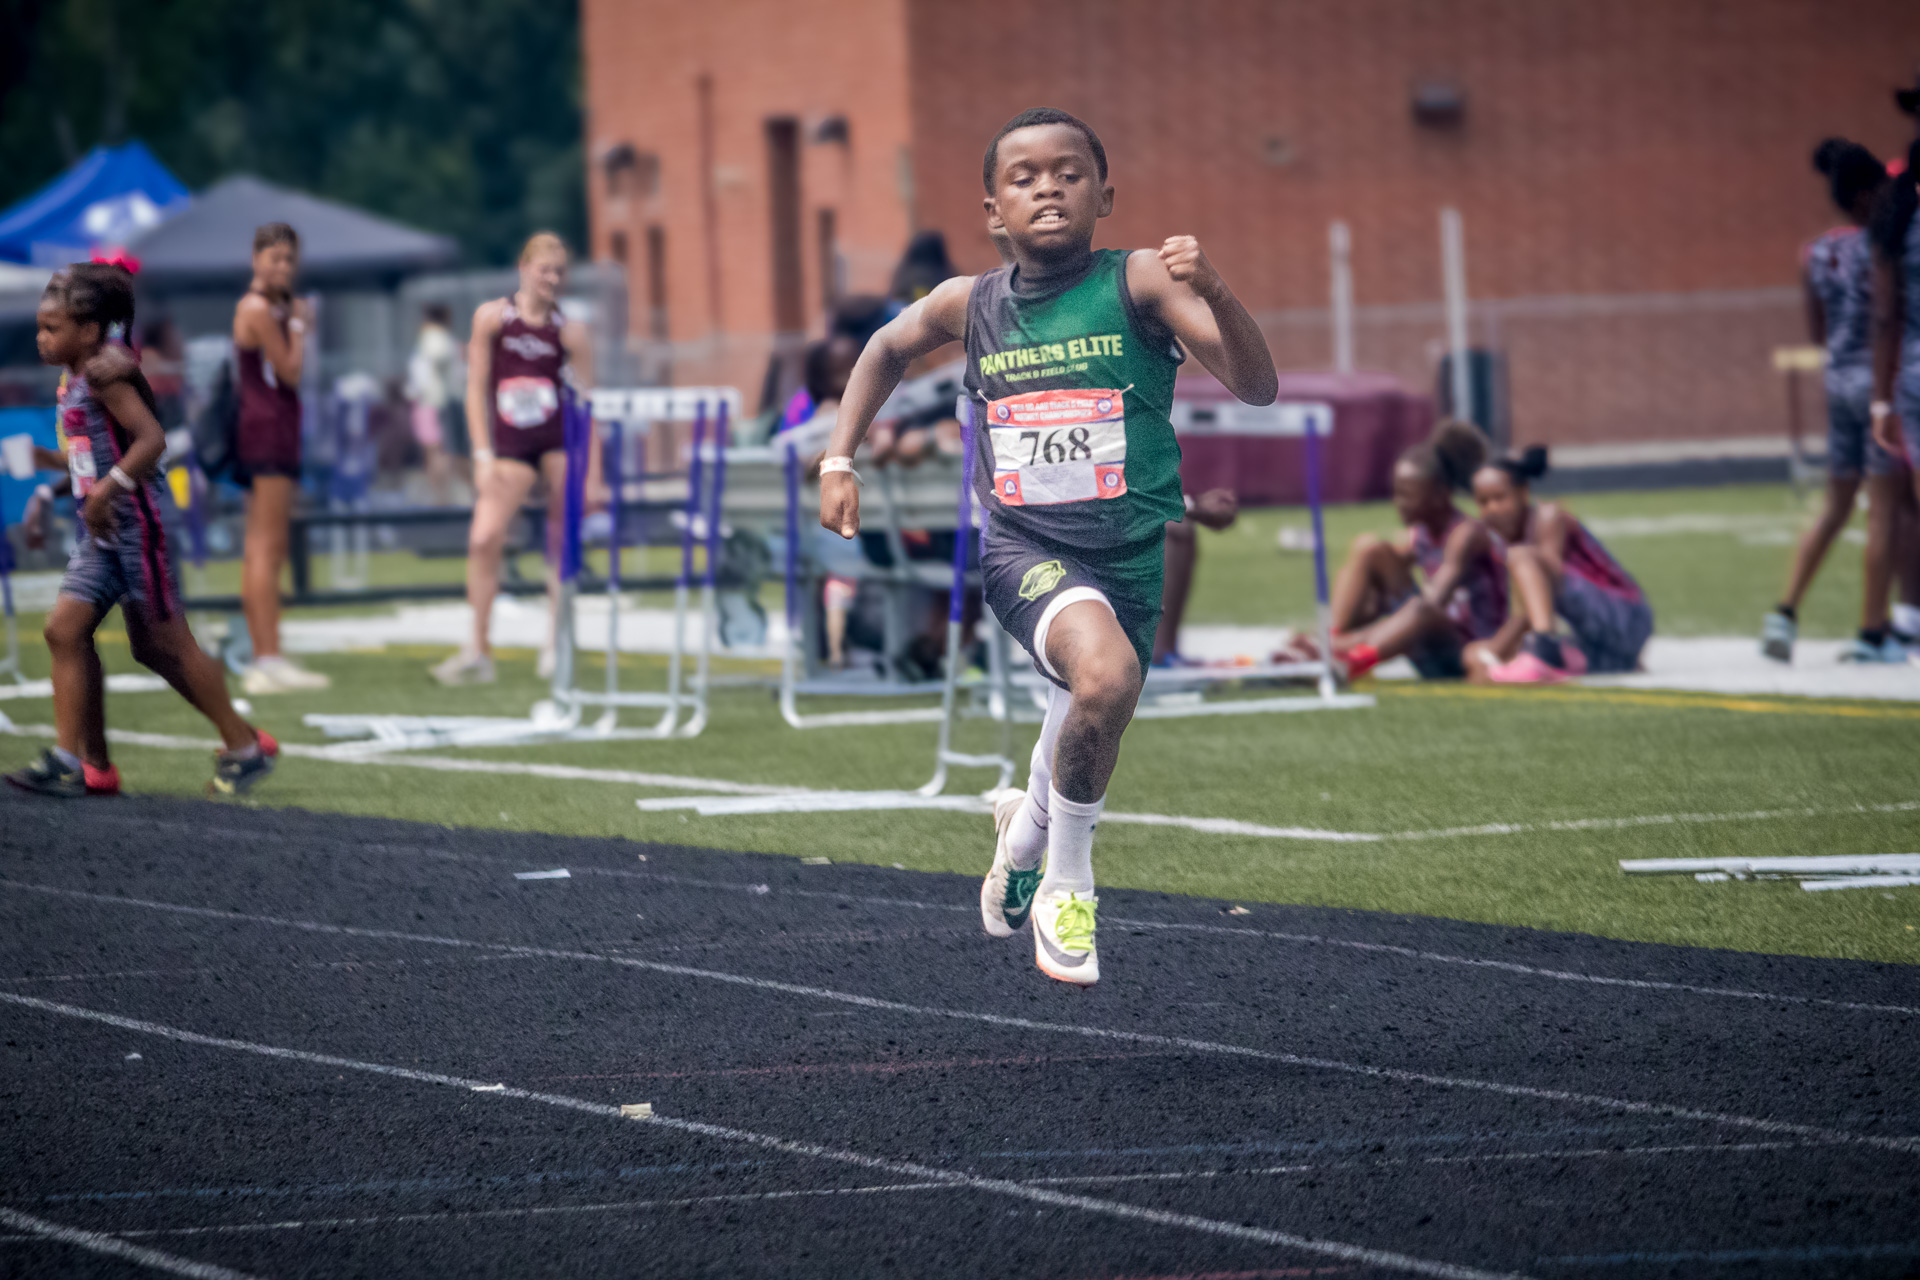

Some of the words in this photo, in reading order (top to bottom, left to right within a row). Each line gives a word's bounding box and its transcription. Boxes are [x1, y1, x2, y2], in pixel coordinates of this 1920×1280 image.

[979, 344, 1066, 378] PANTHERS
[1067, 334, 1124, 359] ELITE
[1004, 371, 1032, 382] TRACK
[1040, 366, 1065, 377] FIELD
[1020, 427, 1092, 466] 768
